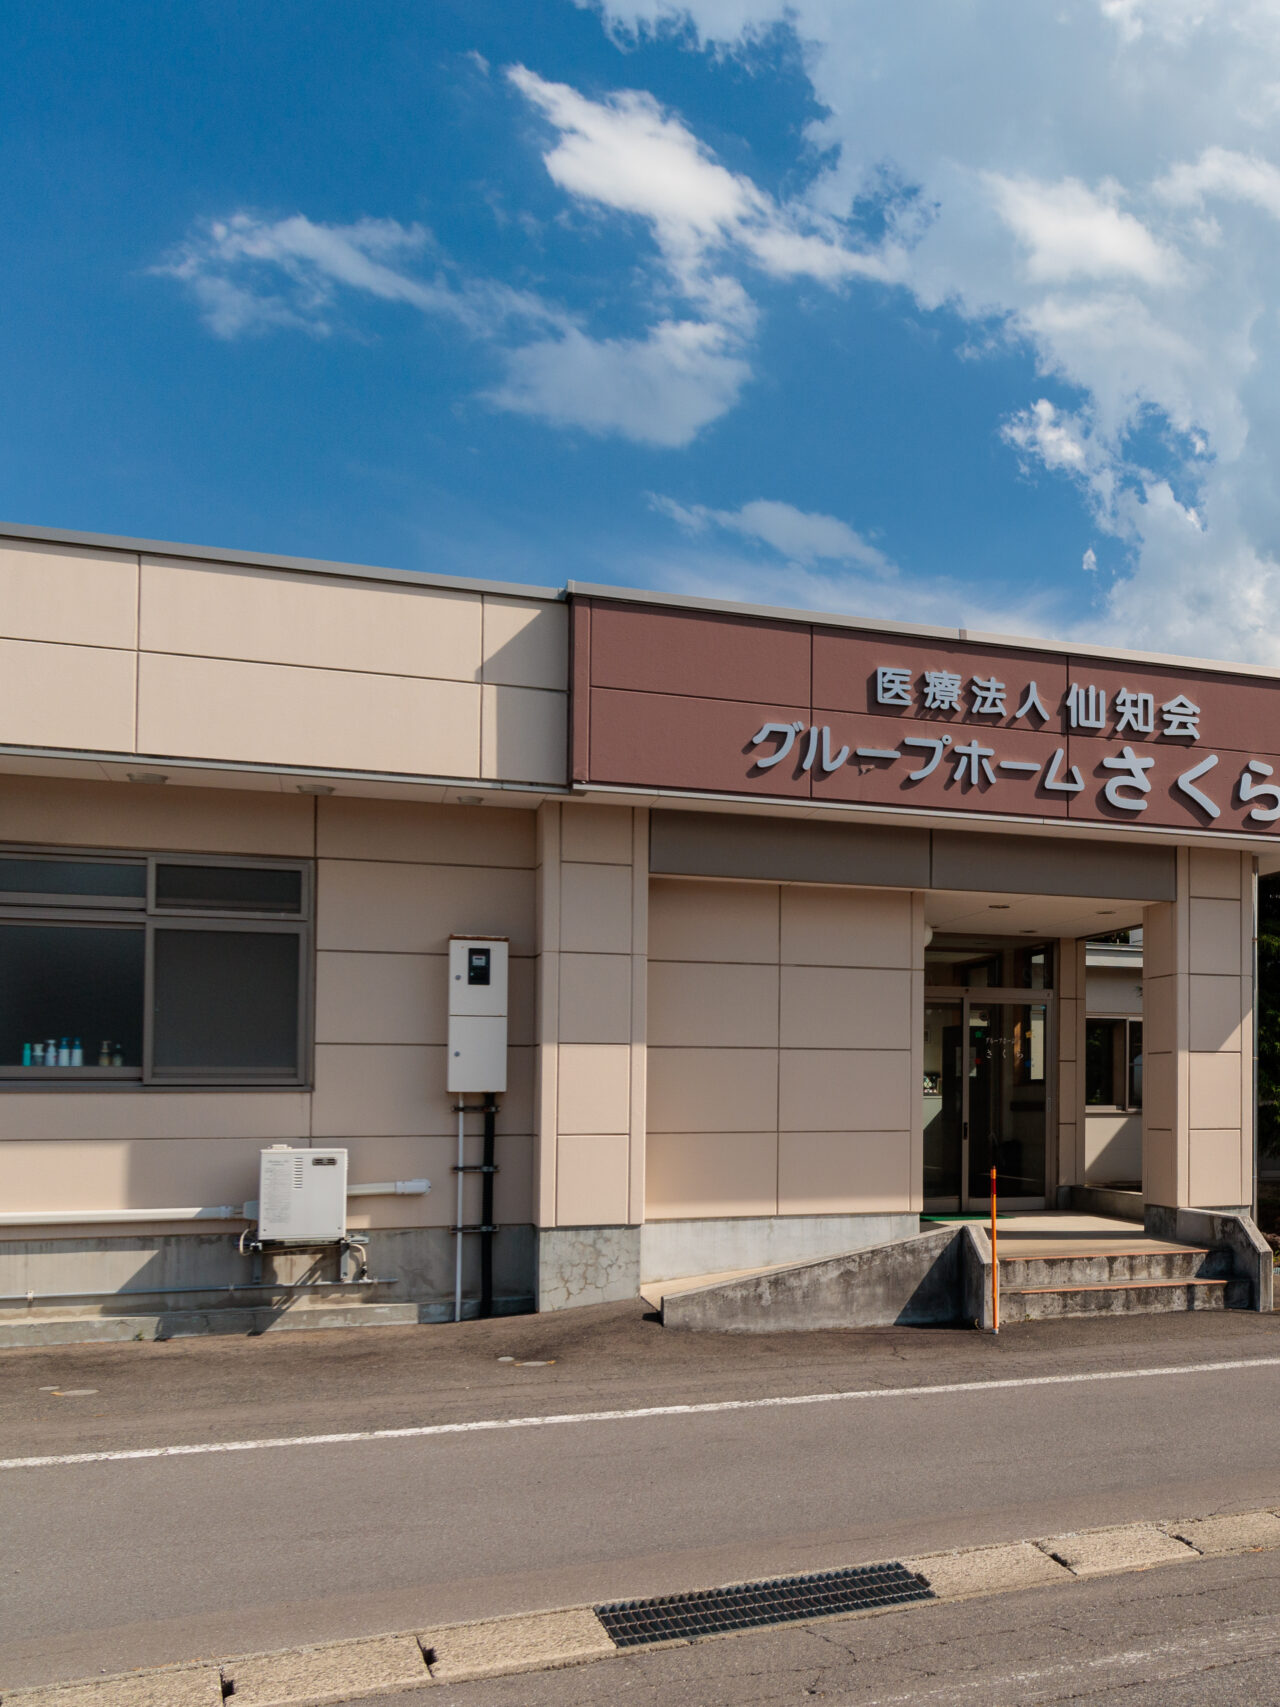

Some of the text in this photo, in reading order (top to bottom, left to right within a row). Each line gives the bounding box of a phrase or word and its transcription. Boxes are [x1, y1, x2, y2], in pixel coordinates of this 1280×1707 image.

[876, 666, 1202, 740] 医療法人仙知会
